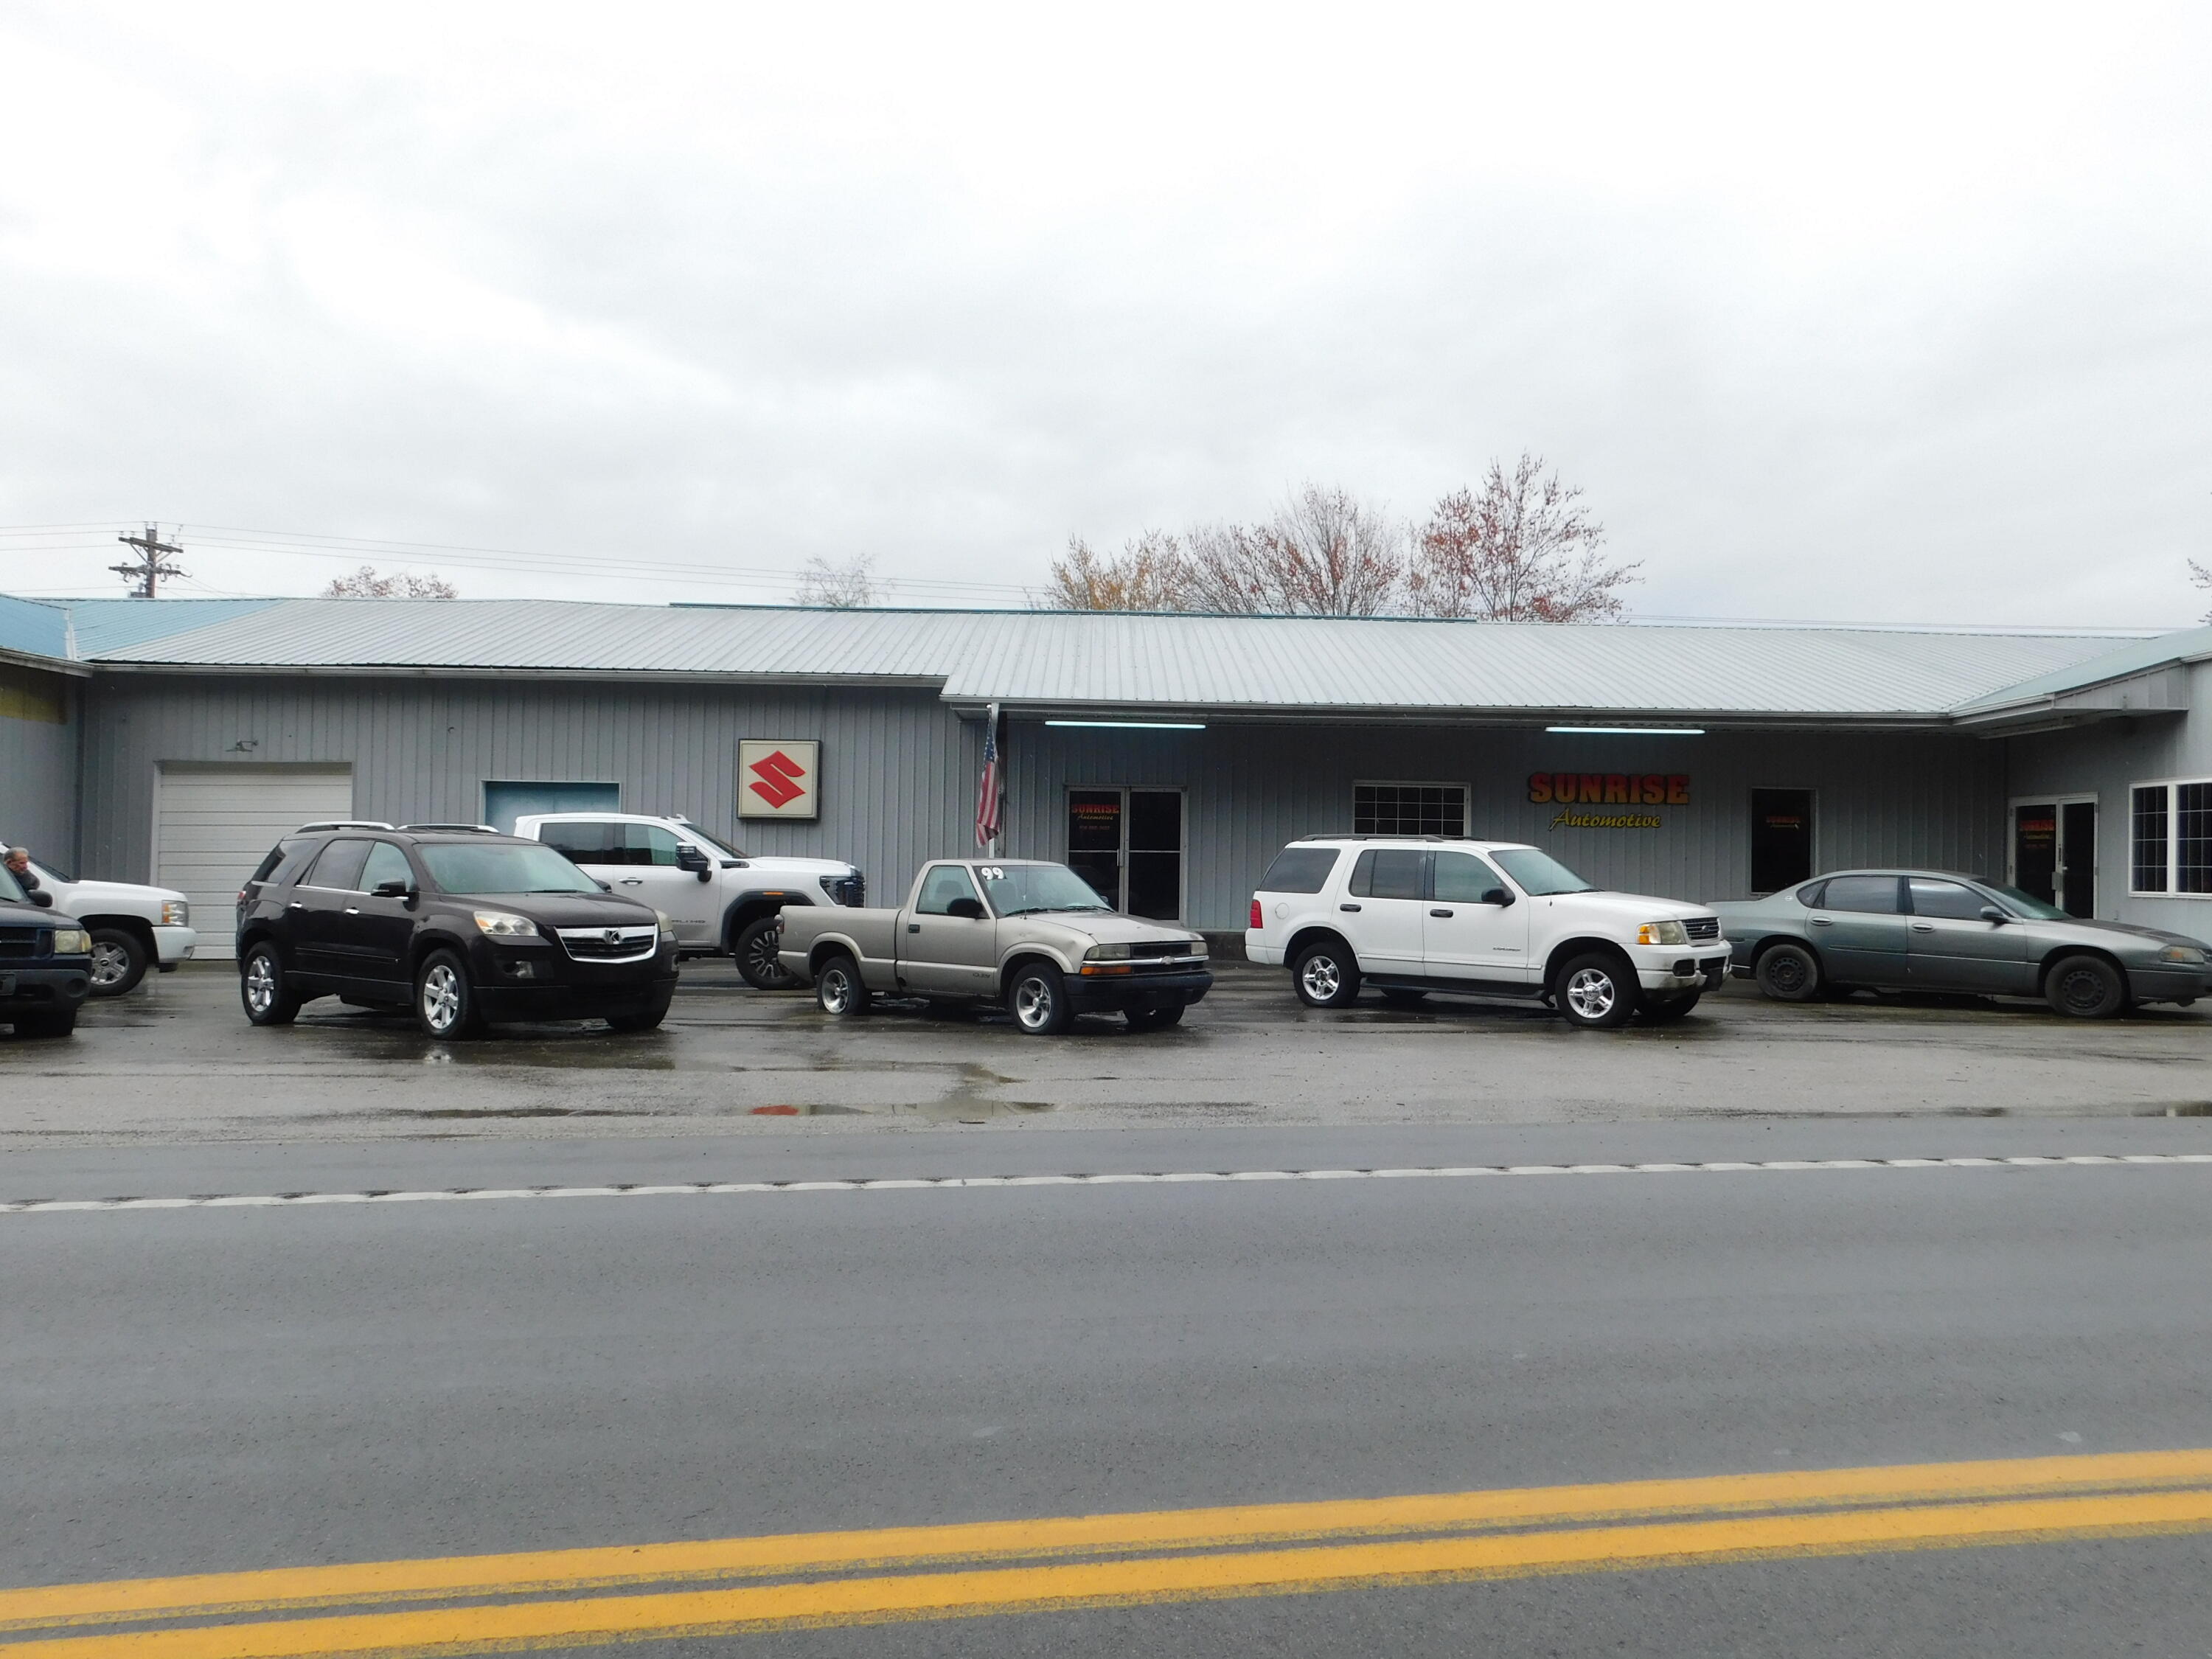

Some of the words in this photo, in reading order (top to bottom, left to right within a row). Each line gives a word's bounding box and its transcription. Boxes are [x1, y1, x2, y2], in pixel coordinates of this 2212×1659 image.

[1528, 772, 1691, 804] SUNRISE
[1071, 804, 1120, 813] SUNRISE
[1548, 808, 1662, 831] Automotive
[981, 867, 1004, 880] 99
